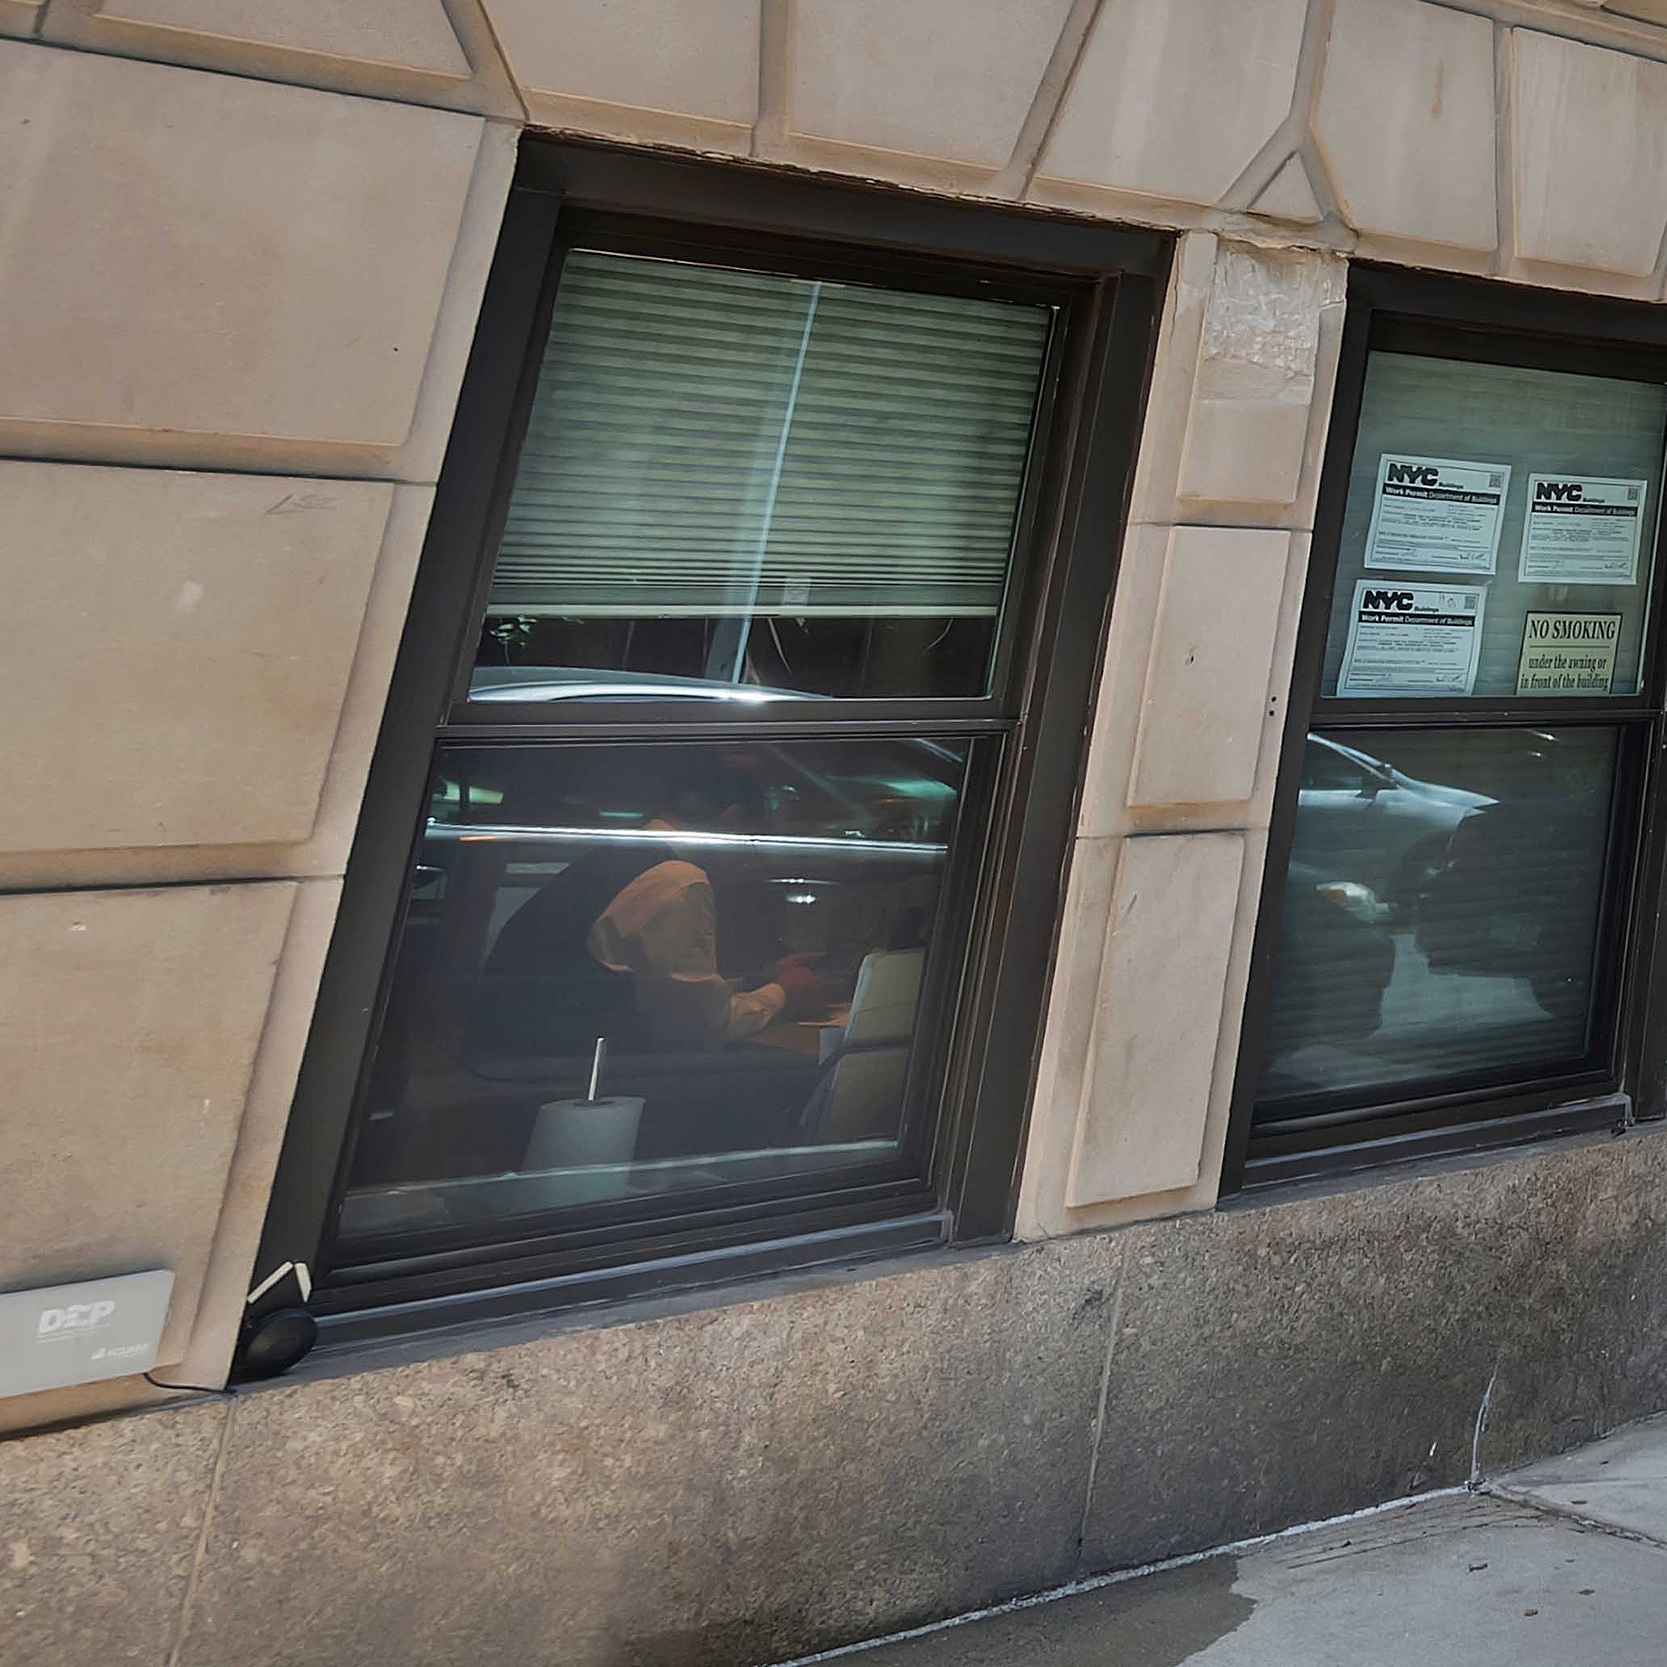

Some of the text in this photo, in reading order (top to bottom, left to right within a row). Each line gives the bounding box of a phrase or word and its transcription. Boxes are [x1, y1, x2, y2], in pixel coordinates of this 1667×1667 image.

[1387, 463, 1439, 486] NYC
[1385, 485, 1404, 495] Work
[1405, 488, 1428, 498] Permit
[1536, 483, 1582, 501] NYC
[1363, 590, 1414, 610] NYC
[1361, 614, 1379, 622] Work
[1381, 614, 1404, 622] Permit
[1529, 620, 1616, 640] NO SMOKING
[1529, 654, 1607, 672] under the awning or
[1520, 674, 1609, 692] in front of the building
[38, 1300, 116, 1334] DEP
